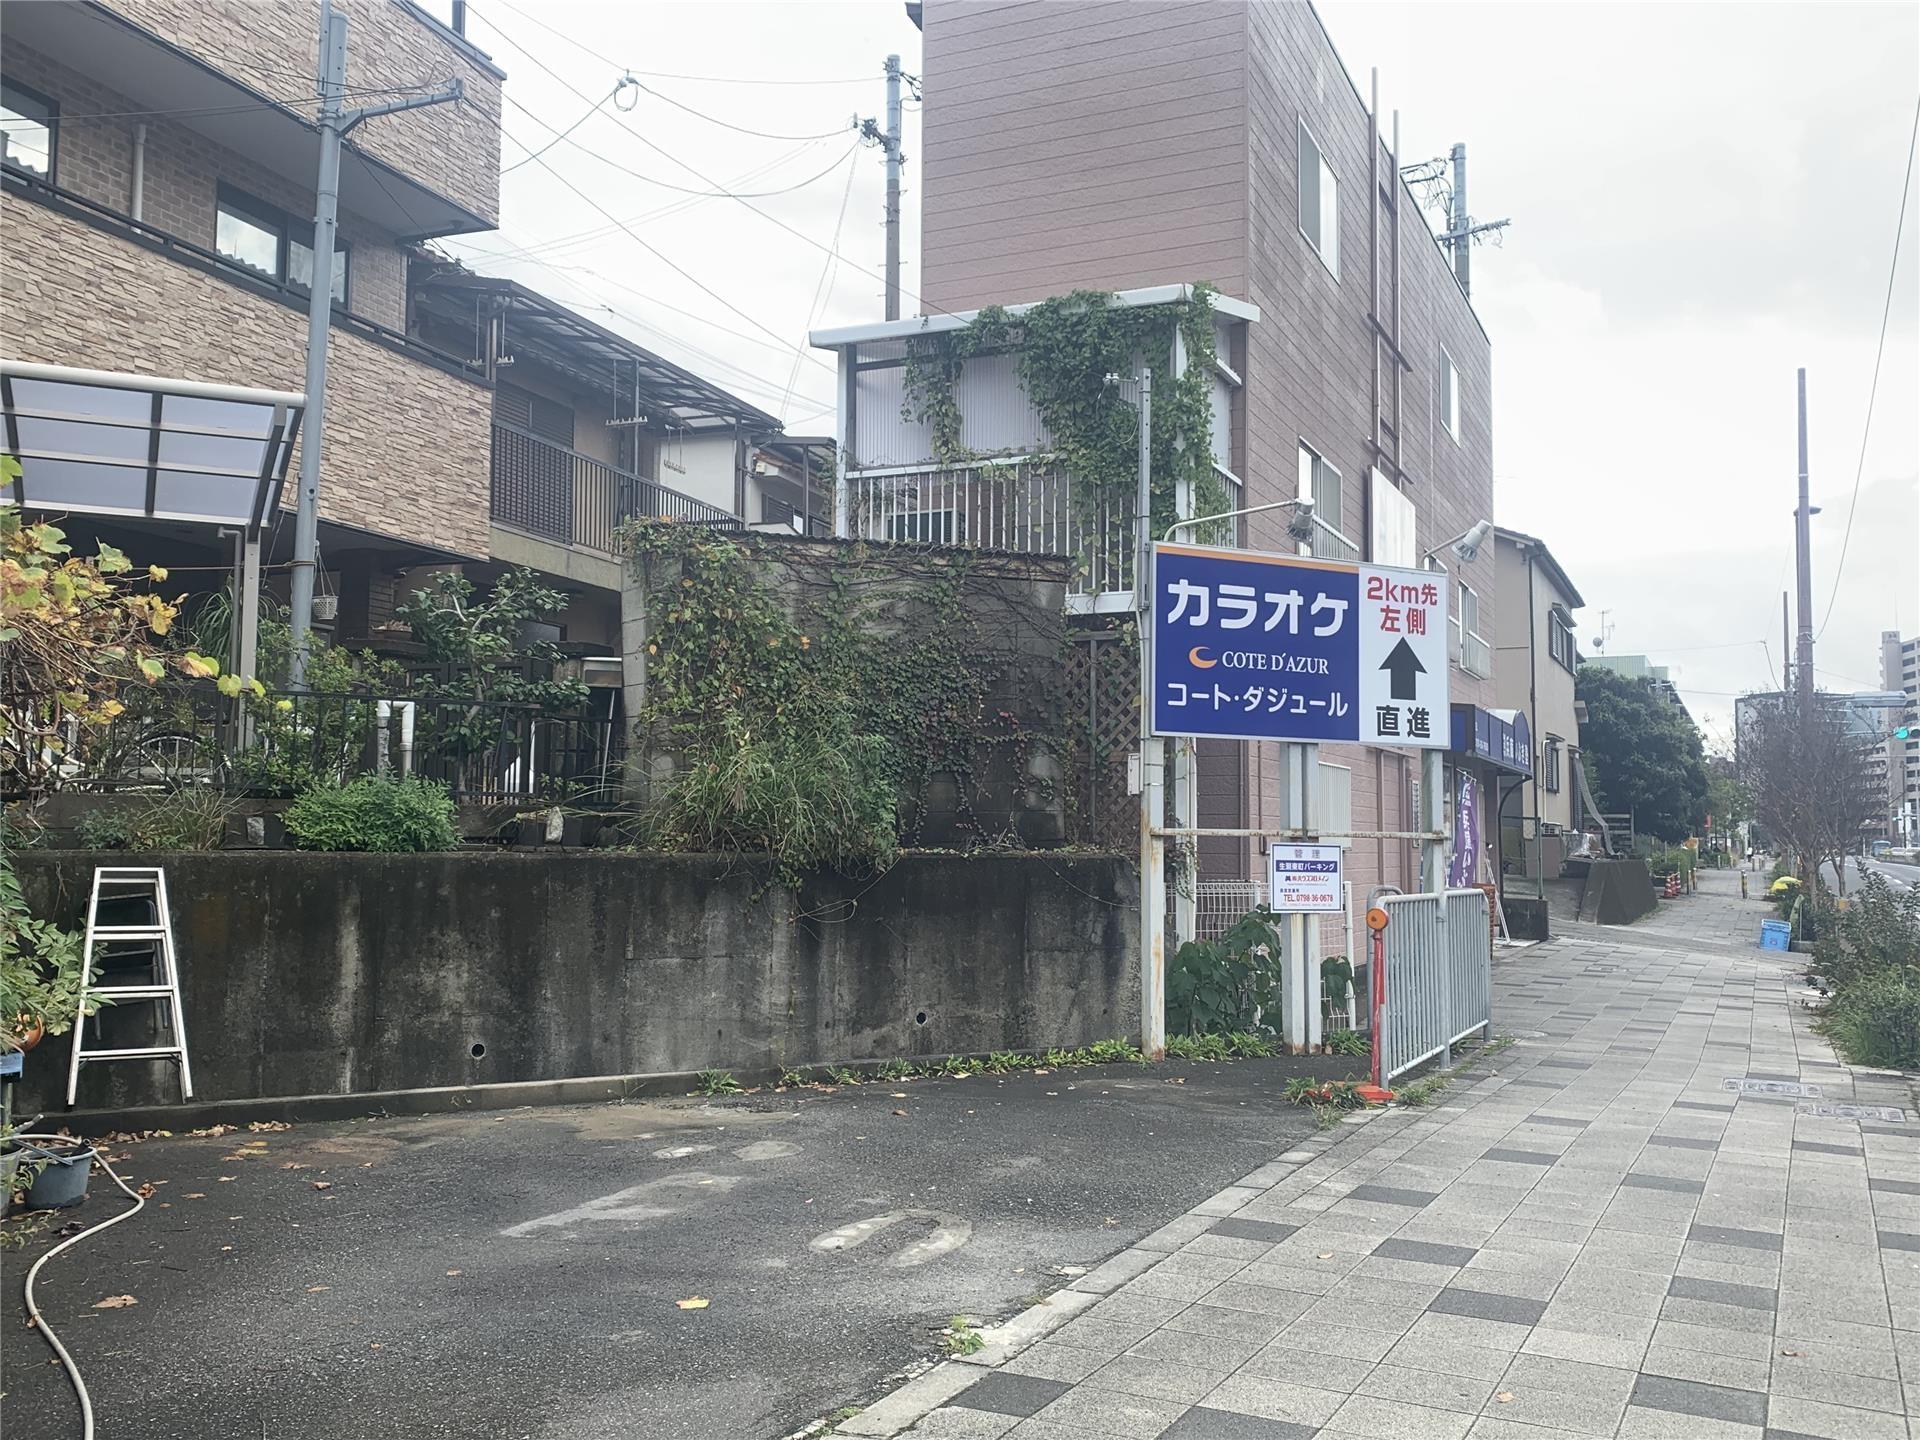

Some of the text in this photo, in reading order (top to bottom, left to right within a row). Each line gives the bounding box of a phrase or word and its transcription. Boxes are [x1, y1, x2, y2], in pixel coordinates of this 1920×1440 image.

[1367, 576, 1438, 606] 2km先
[1167, 578, 1348, 637] カラオケ
[1380, 605, 1426, 636] 左側
[1222, 650, 1267, 671] COTE
[1167, 682, 1348, 717] コート・ダジュール
[1376, 705, 1431, 739] 直進
